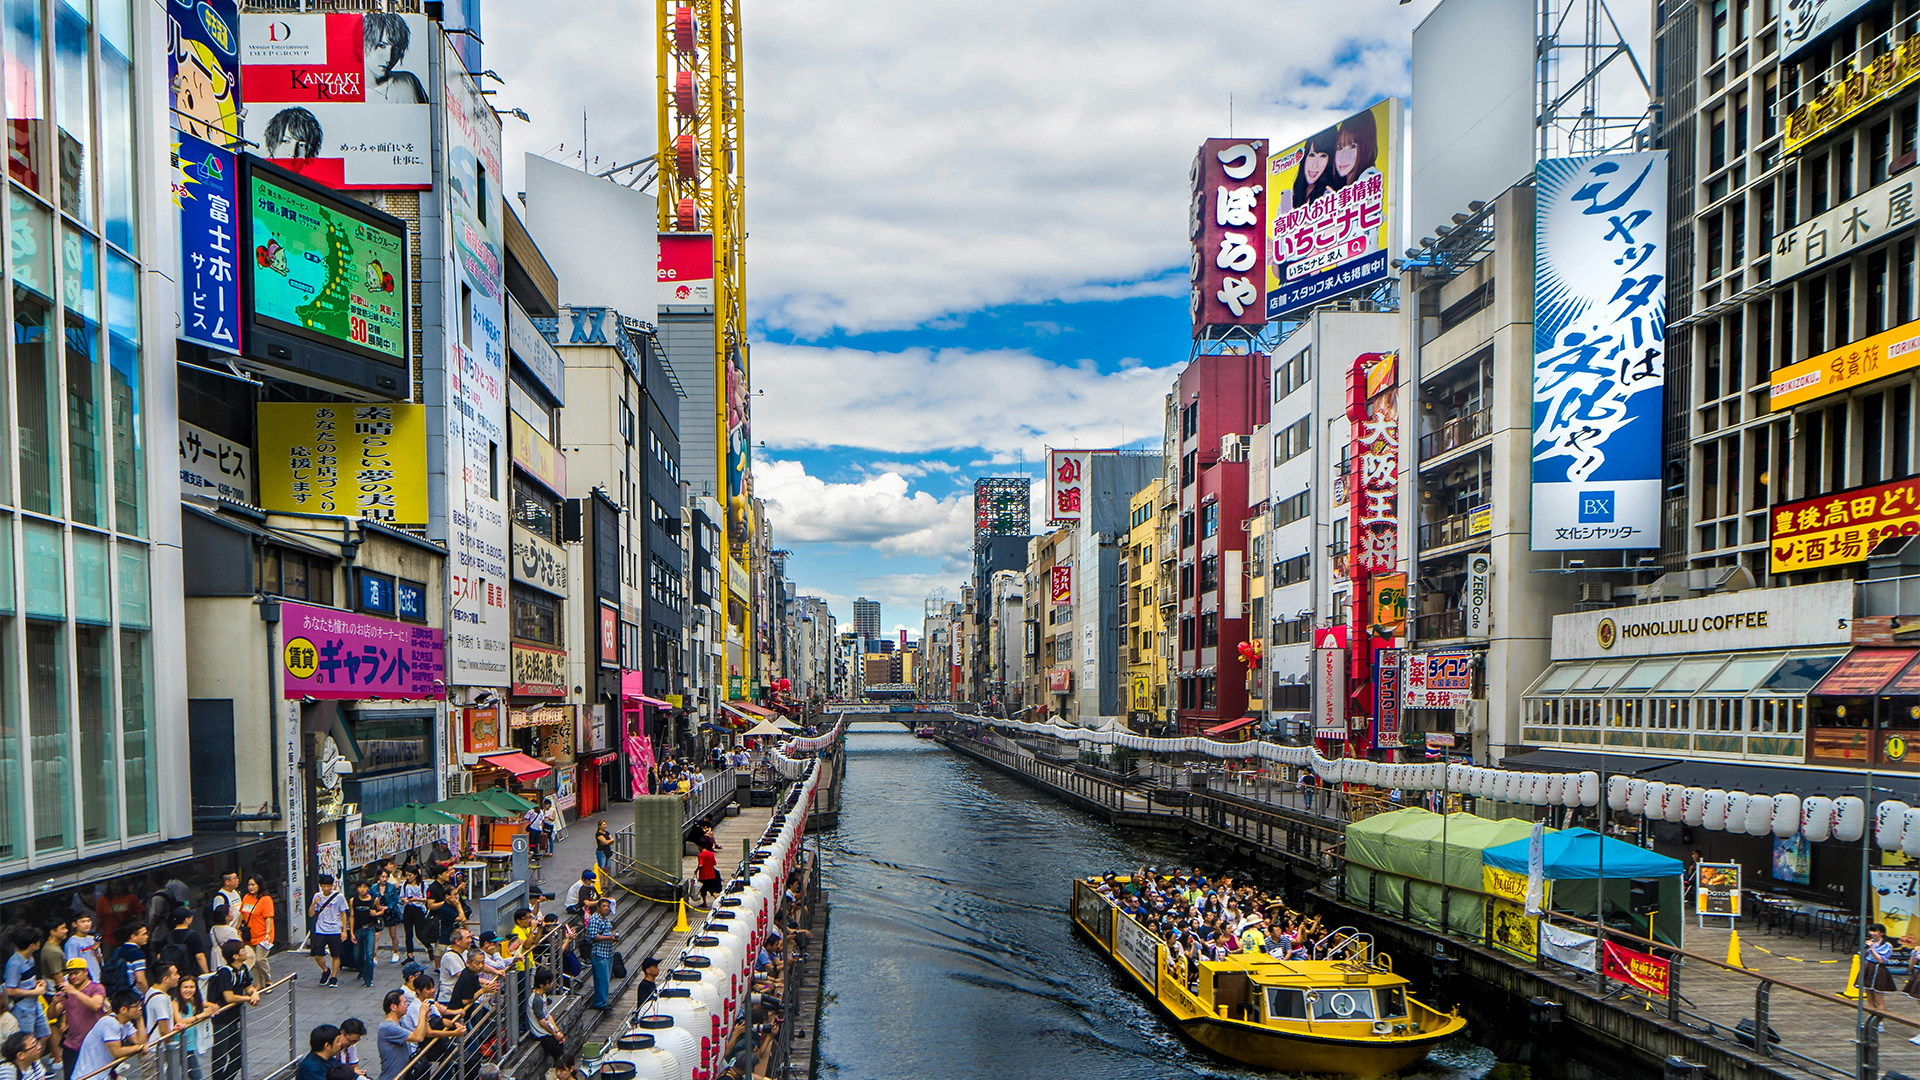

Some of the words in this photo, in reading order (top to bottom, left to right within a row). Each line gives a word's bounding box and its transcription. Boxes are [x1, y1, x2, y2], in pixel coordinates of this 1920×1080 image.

[290, 70, 360, 89] KANZAKI
[317, 83, 360, 99] RUKA
[340, 142, 414, 153] めっちゃ面白いを
[392, 155, 426, 166] 仕事に。
[1273, 174, 1383, 236] 高収入お仕事情報
[1216, 140, 1263, 317] づぼらや
[1273, 194, 1382, 263] いちごナビ
[1776, 231, 1797, 257] 4F
[1805, 182, 1916, 266] 白木屋
[207, 194, 233, 343] 富士ホーム
[1289, 256, 1326, 278] いちごナビ
[1327, 249, 1343, 262] 求人
[190, 252, 207, 330] サービス
[1269, 257, 1385, 310] 店舗・スタッフ求人も掲載中!
[350, 316, 367, 343] 30
[289, 446, 313, 504] 応援します
[315, 408, 339, 513] あなたのお店づくり
[1358, 411, 1399, 572] 大阪王将
[1582, 499, 1610, 514] BX
[1797, 530, 1863, 563] 酒場
[1473, 575, 1484, 607] ZERO
[302, 614, 409, 642] あなたも憧れのお店のオーナーに!
[1621, 618, 1698, 639] HONOLULU
[1702, 611, 1768, 631] COFFEE
[288, 646, 315, 669] 賃貸
[319, 638, 411, 685] ギャラント
[1409, 657, 1425, 687] 薬
[1428, 658, 1469, 678] ダイコク
[1382, 669, 1396, 710] ダイコク
[1425, 691, 1450, 707] 免税
